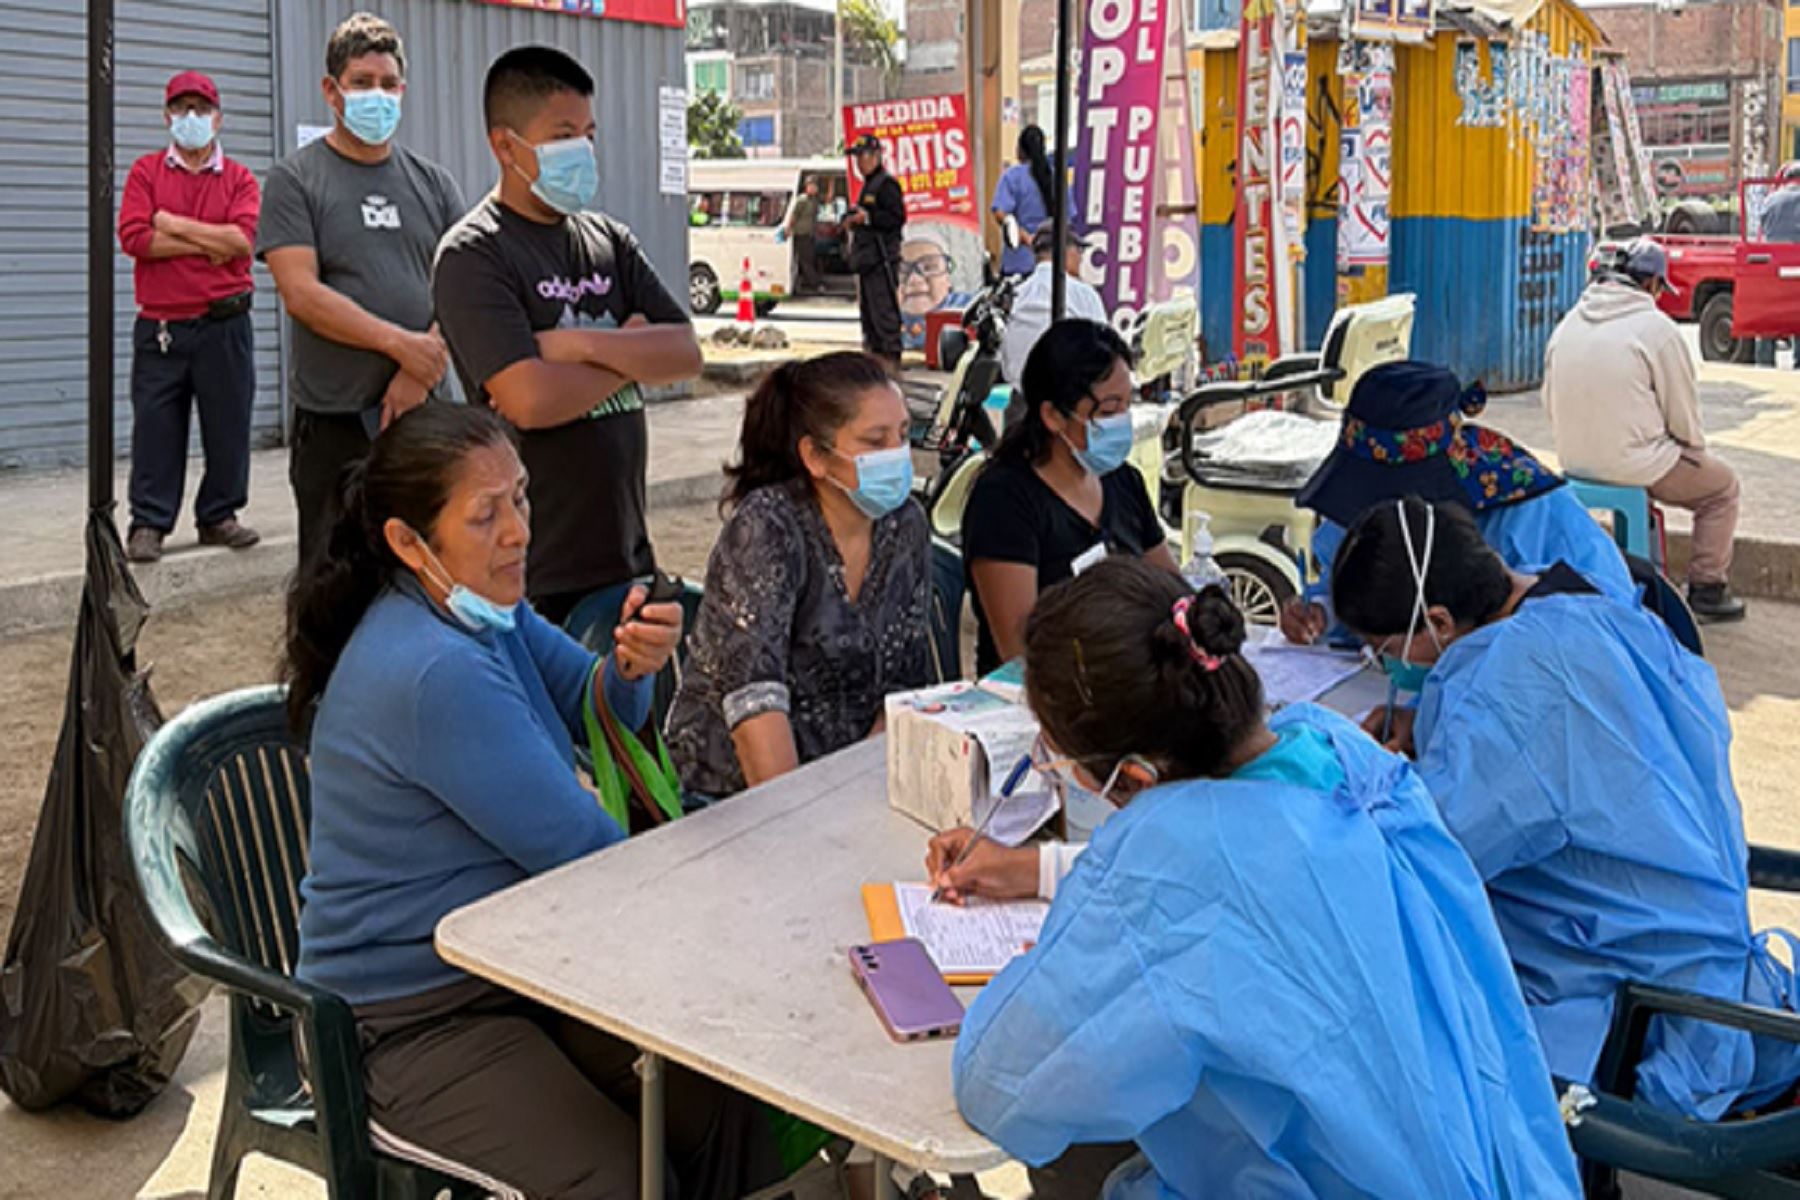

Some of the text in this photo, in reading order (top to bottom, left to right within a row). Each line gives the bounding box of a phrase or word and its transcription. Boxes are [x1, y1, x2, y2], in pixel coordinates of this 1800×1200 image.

[853, 96, 955, 128] MEDIDA
[852, 128, 967, 182] RATIS
[1112, 106, 1153, 344] PUEBLO
